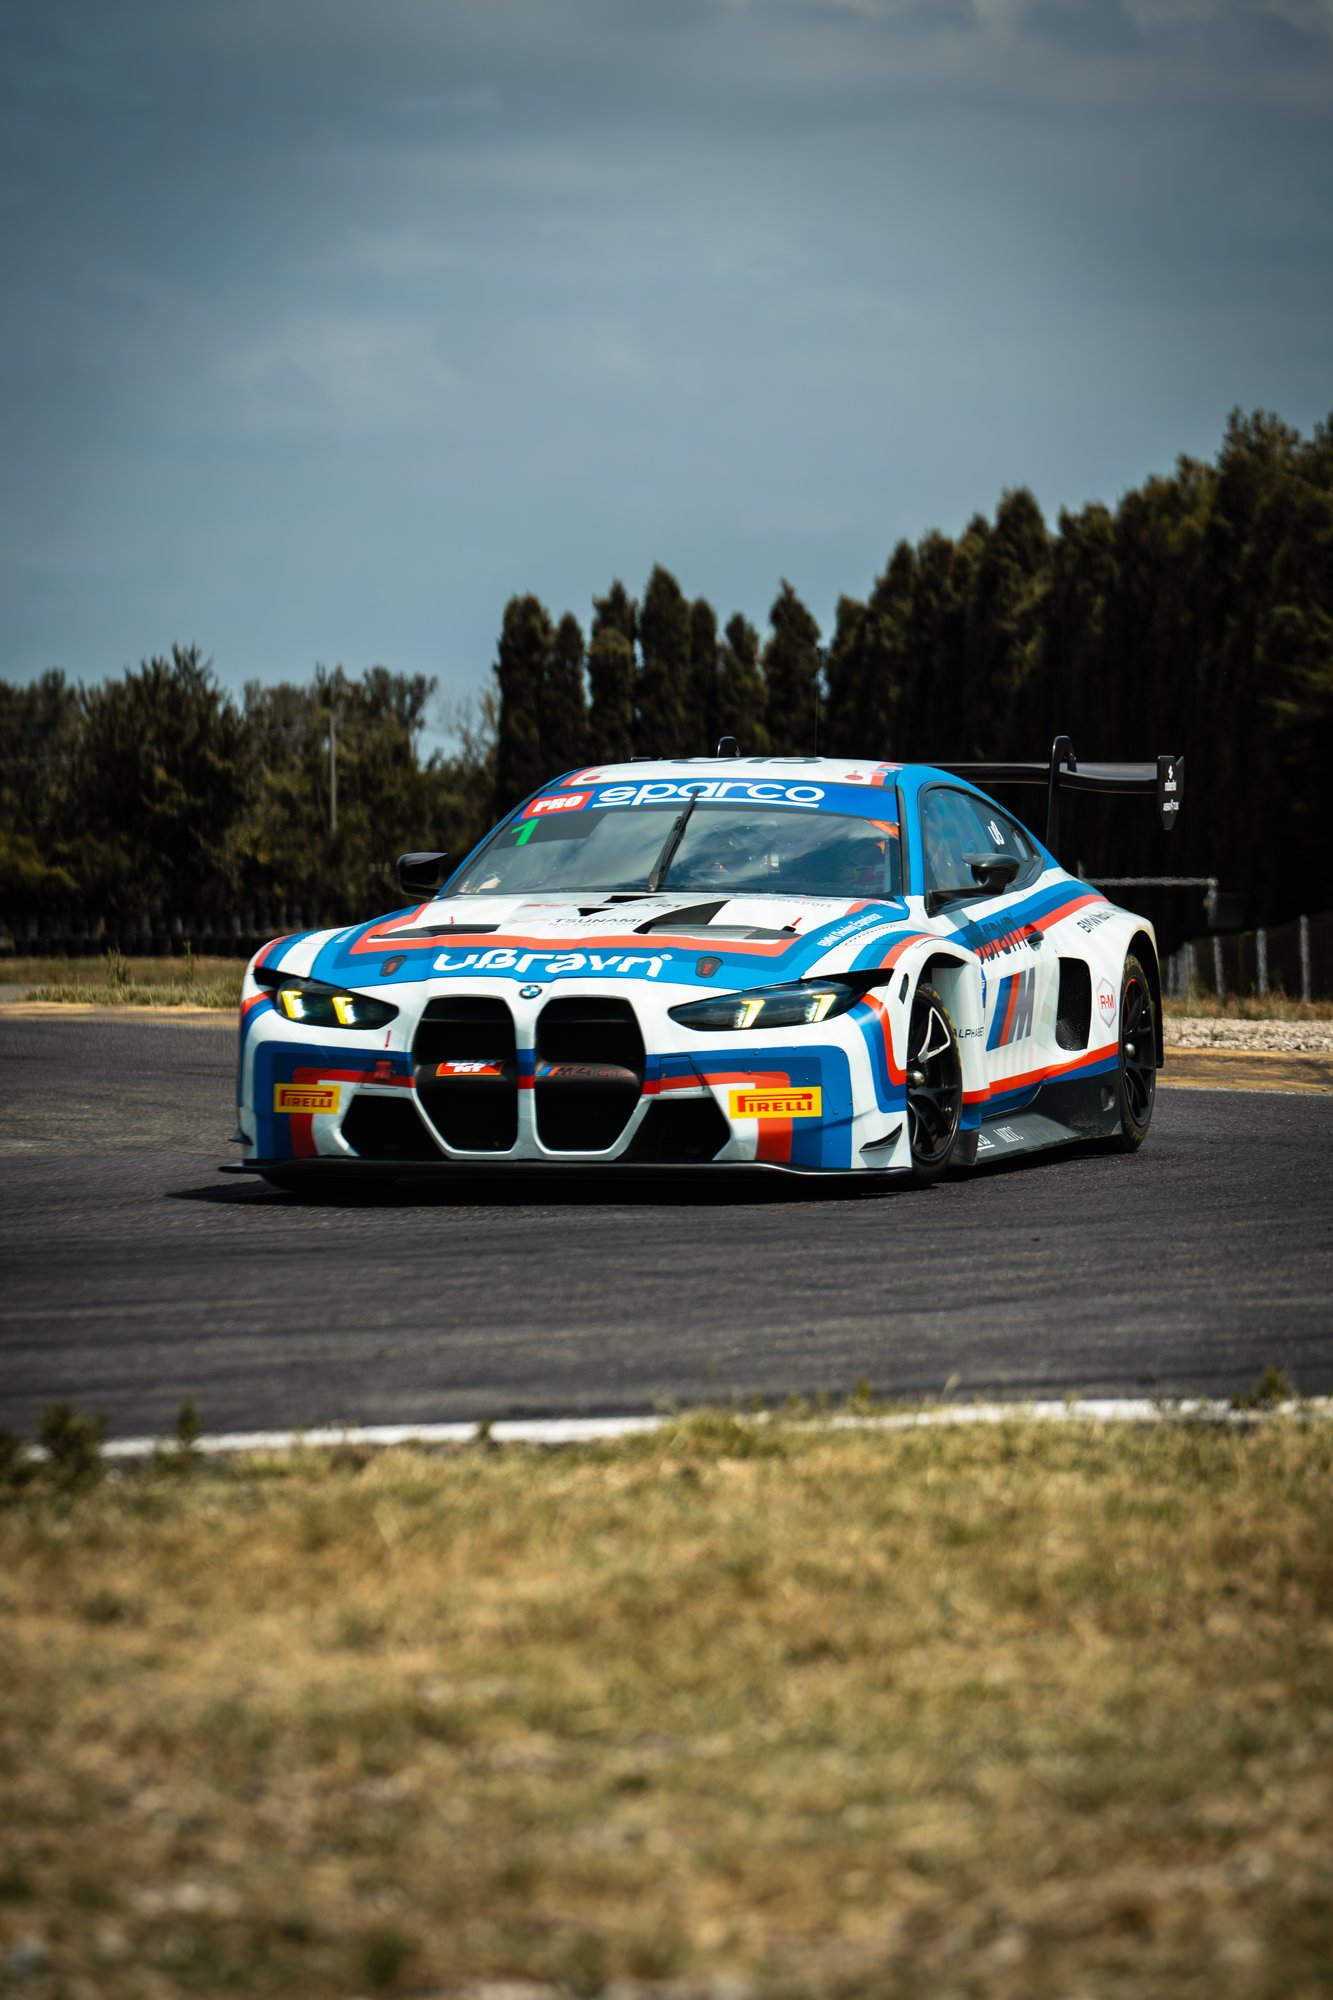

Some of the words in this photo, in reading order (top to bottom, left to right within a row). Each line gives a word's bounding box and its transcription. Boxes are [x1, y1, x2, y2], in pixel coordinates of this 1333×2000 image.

[597, 781, 826, 806] sparco
[531, 795, 584, 813] PRO
[511, 818, 541, 847] 1
[280, 1089, 333, 1108] PIRELLI
[737, 1093, 813, 1113] PIRELLI
